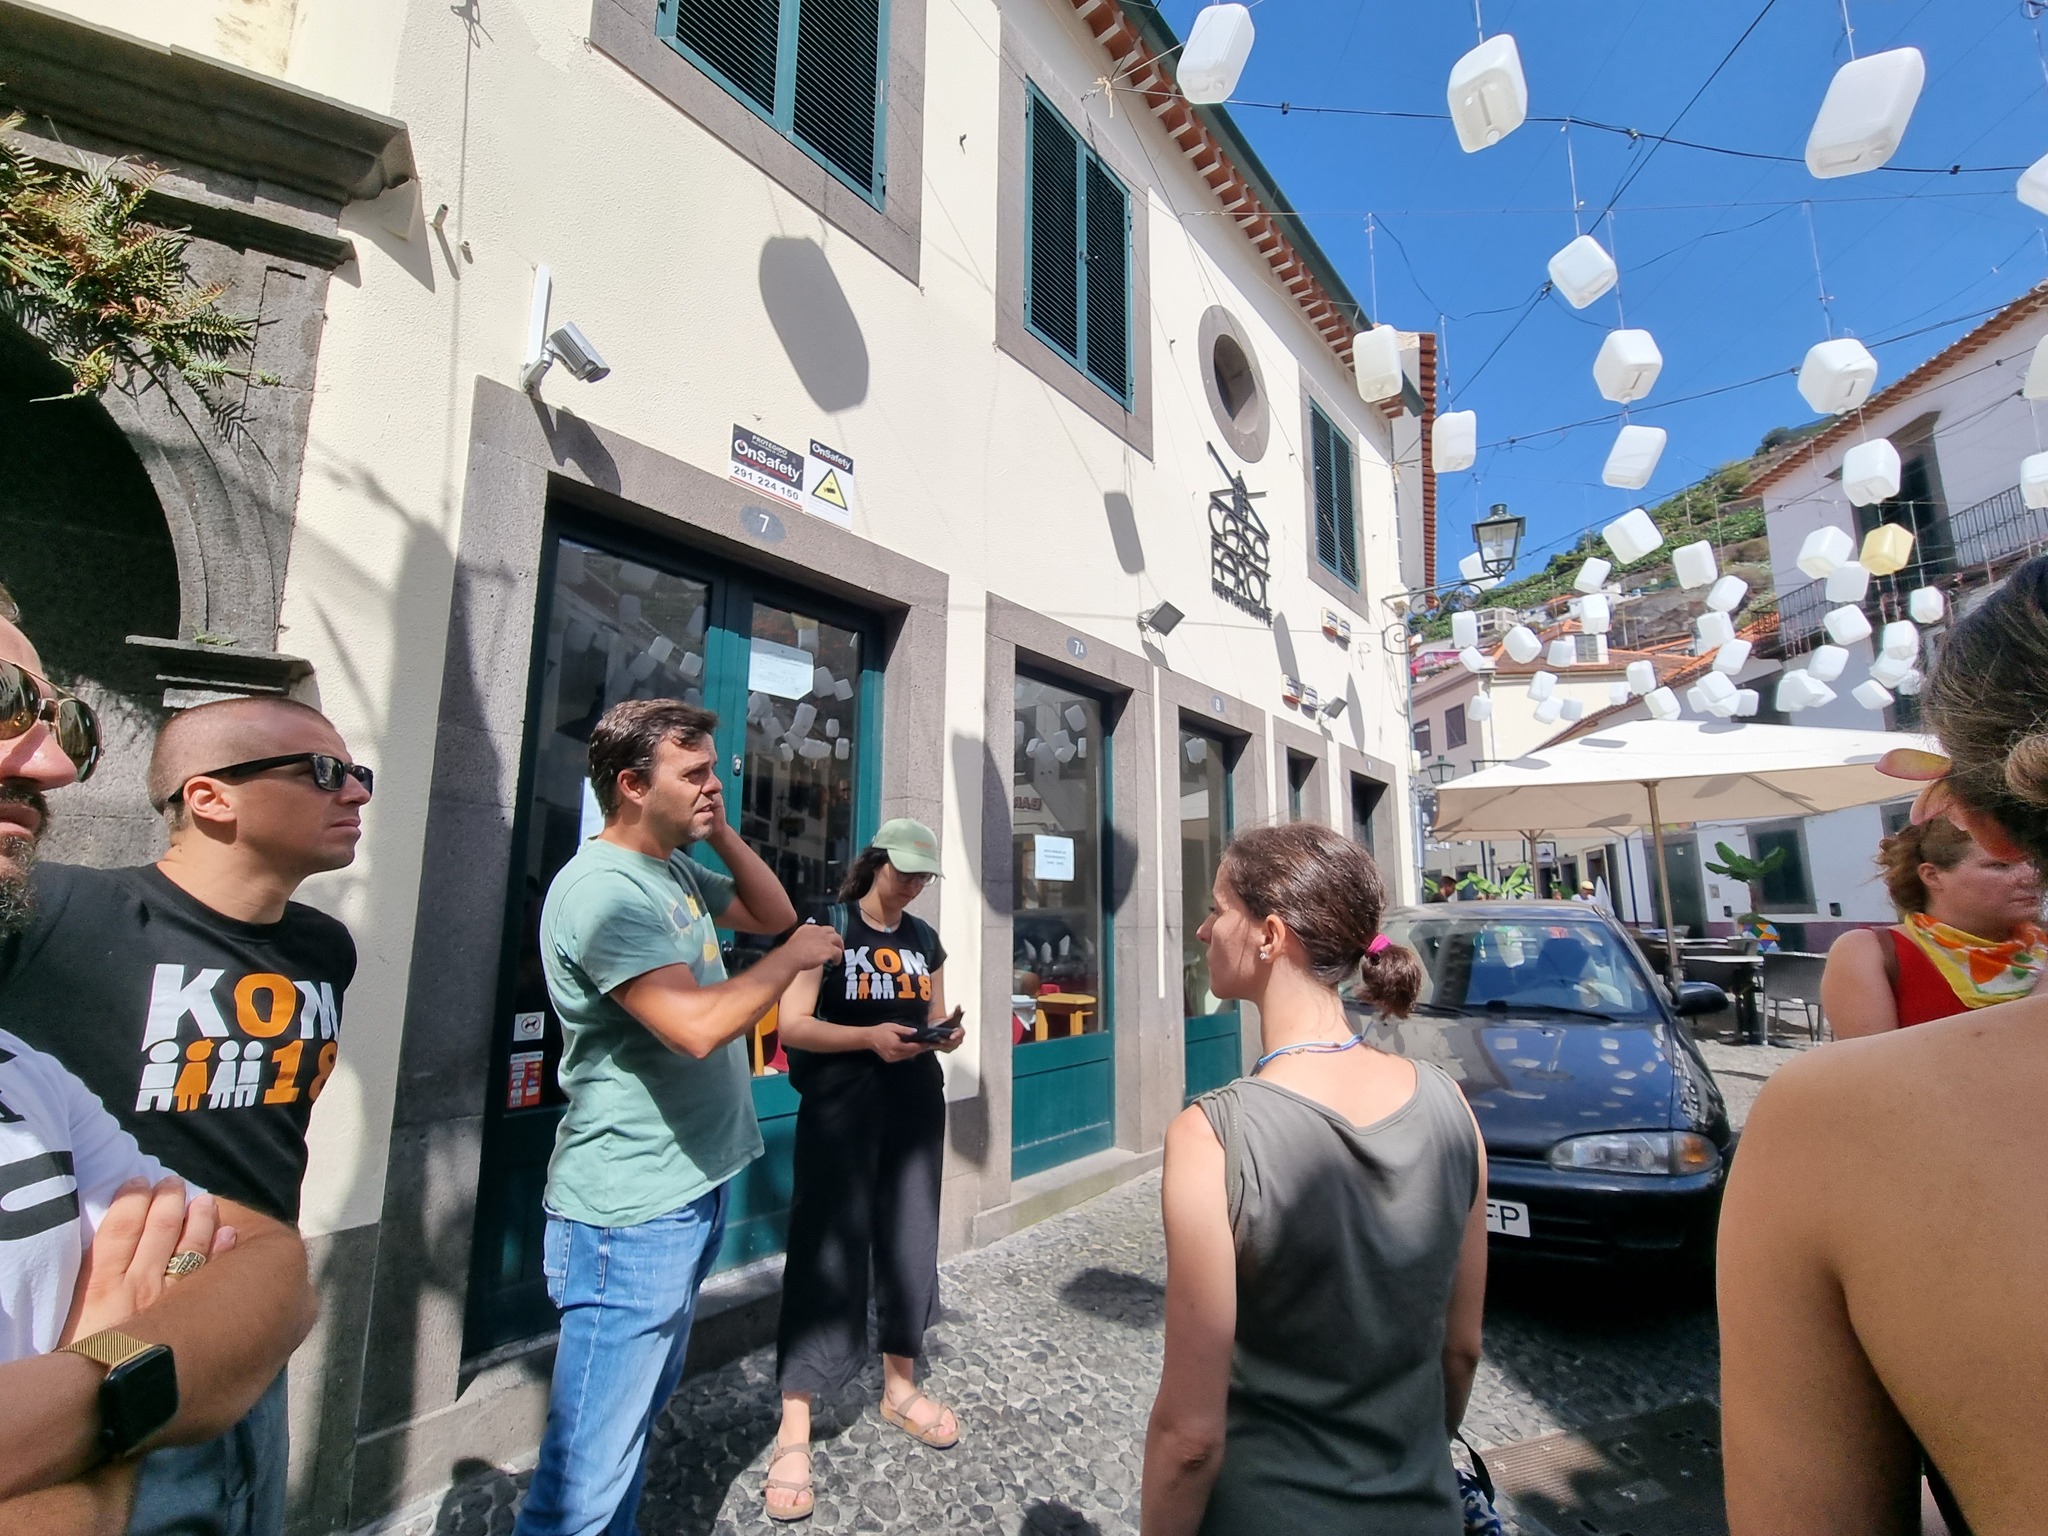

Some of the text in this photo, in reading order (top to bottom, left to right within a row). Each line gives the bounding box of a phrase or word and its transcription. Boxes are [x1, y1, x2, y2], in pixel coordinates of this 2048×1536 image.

[734, 439, 802, 483] OnSafety
[812, 443, 851, 470] OnSafety
[734, 466, 799, 500] 291 224 150
[759, 514, 770, 533] 7
